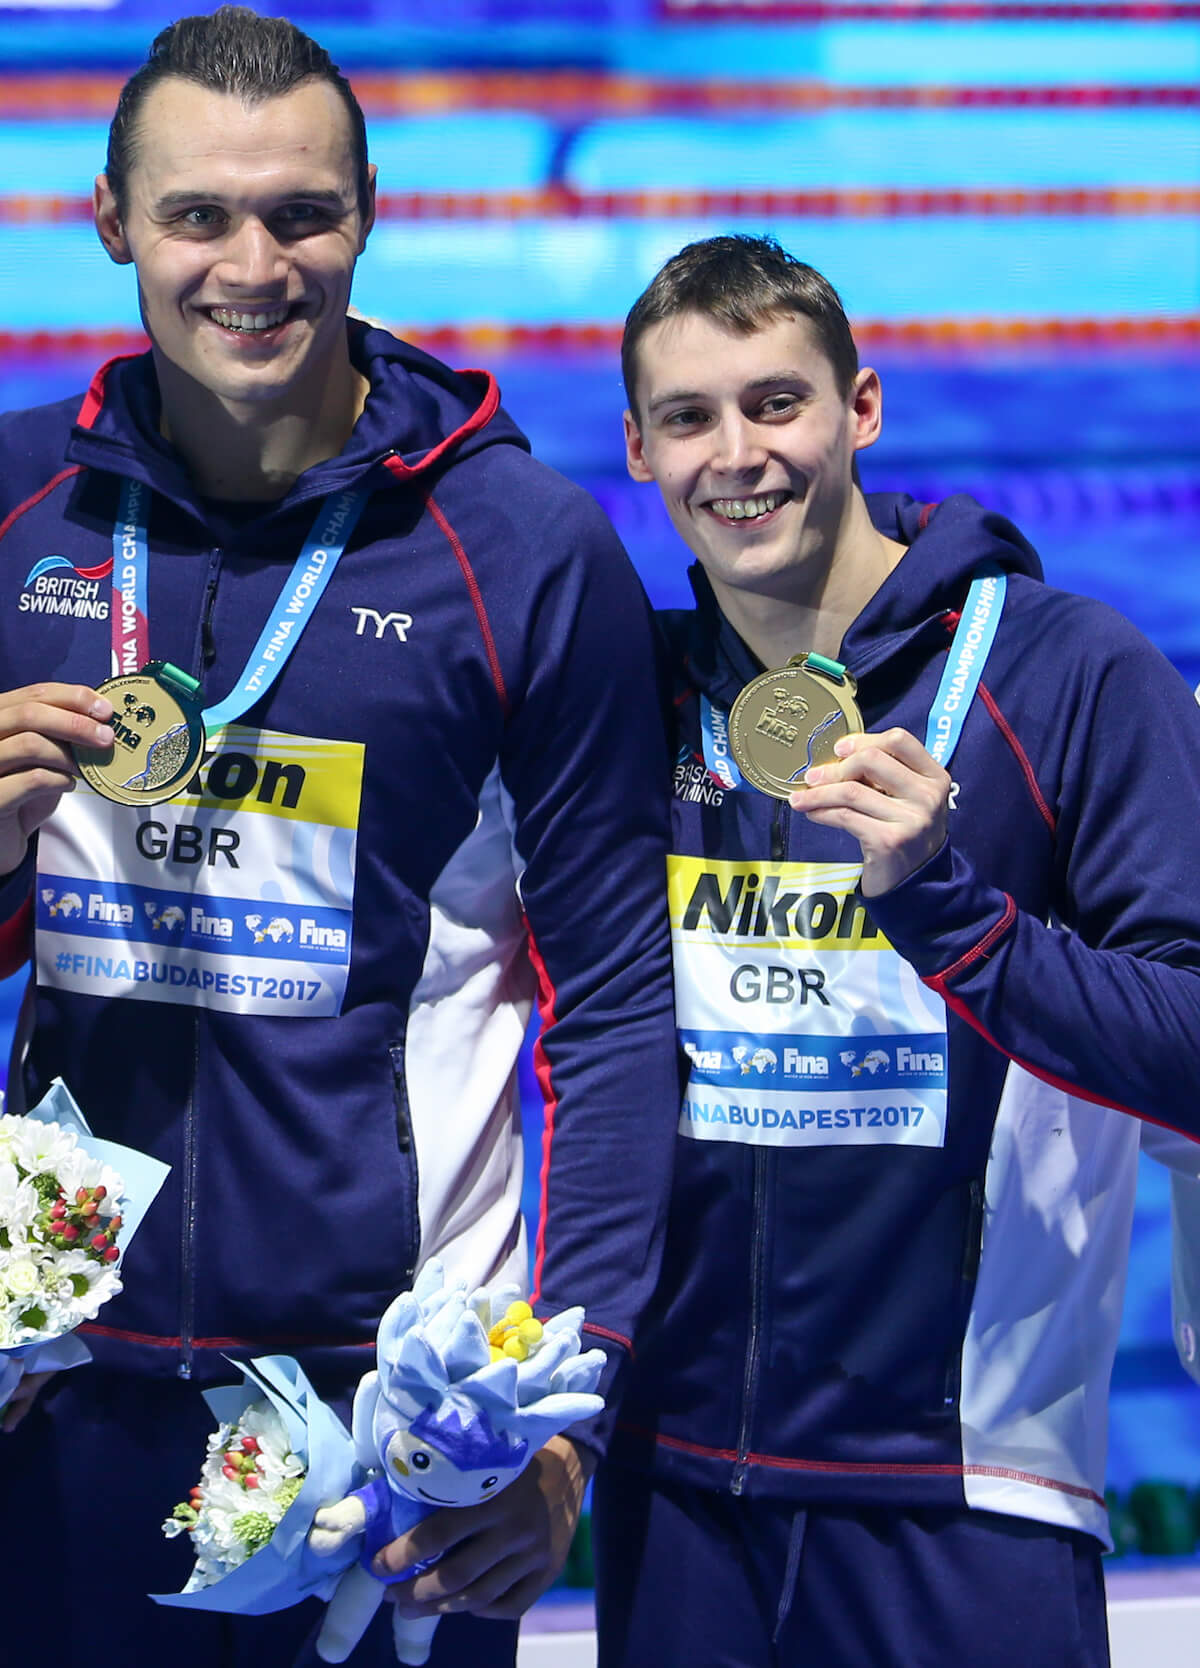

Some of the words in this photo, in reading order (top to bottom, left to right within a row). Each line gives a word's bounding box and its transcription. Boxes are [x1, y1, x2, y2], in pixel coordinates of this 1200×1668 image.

[18, 593, 110, 620] SWIMMING
[35, 576, 100, 600] BRITISH
[121, 565, 138, 634] WORLD
[244, 664, 268, 692] 17th
[262, 620, 297, 662] FINA
[285, 549, 329, 615] WORLD
[351, 607, 414, 642] TYR
[122, 638, 138, 675] INA
[931, 715, 952, 764] ORLD
[135, 820, 241, 869] GBR
[88, 894, 134, 923] Fina
[191, 907, 233, 937] Fina
[300, 919, 346, 947] Fina
[682, 873, 879, 939] Nikon
[56, 952, 322, 1001] #FINABUDAPEST2017
[729, 964, 831, 1006] GBR
[784, 1048, 829, 1074] Fina
[896, 1047, 944, 1071] Fina
[683, 1102, 925, 1129] INABUDAPEST2017
